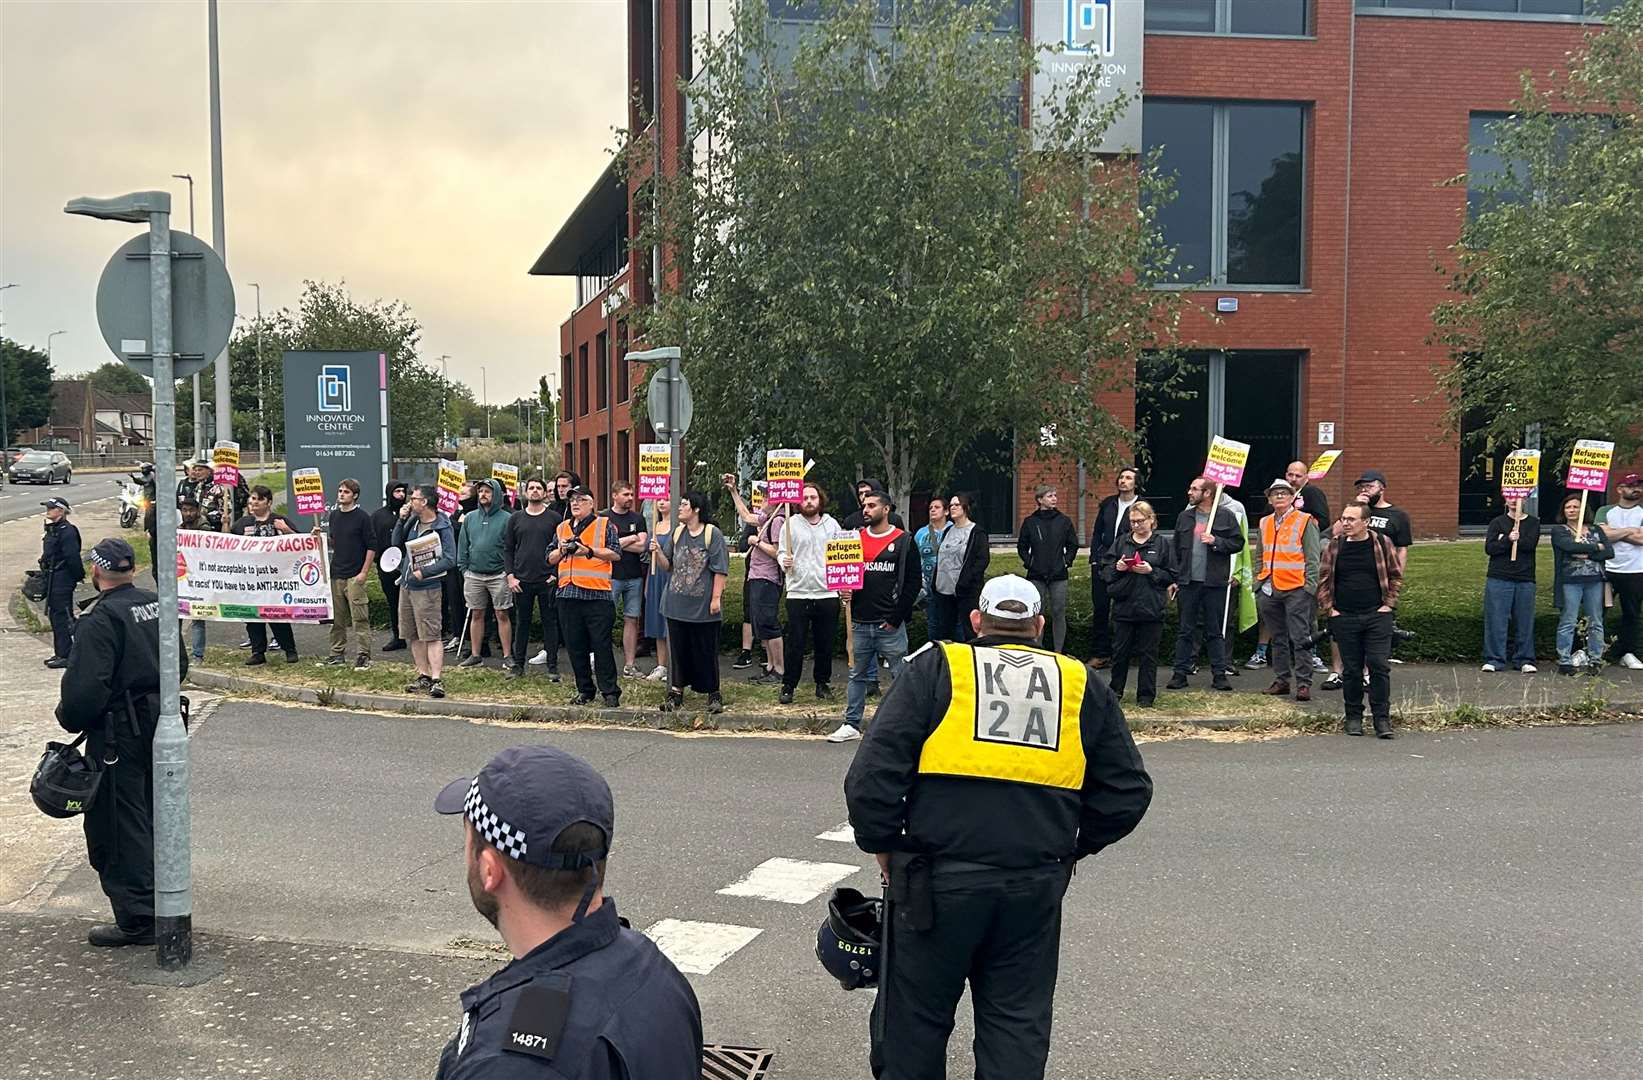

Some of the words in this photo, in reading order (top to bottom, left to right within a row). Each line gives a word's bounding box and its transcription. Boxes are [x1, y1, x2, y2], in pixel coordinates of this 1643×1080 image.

[306, 414, 365, 423] INNOVATION
[317, 422, 354, 431] CENTRE
[1212, 444, 1246, 458] Refugees
[1574, 448, 1610, 459] Refugees
[641, 455, 669, 465] Refugees
[1211, 453, 1243, 464] welcome
[1573, 457, 1607, 466] welcome
[641, 464, 668, 472] welcome
[769, 460, 802, 470] Refugees
[769, 469, 800, 477] welcome
[1571, 467, 1589, 477] Stop
[1590, 469, 1604, 477] the
[641, 476, 655, 485] Stop
[656, 476, 666, 484] the
[769, 481, 785, 490] Stop
[787, 480, 800, 489] the
[1570, 475, 1581, 483] far
[1582, 476, 1602, 486] right
[640, 485, 651, 493] far
[651, 485, 665, 495] right
[769, 490, 780, 498] far
[781, 489, 799, 499] right
[205, 535, 241, 550] STAND
[241, 539, 258, 551] UP
[259, 540, 275, 553] TO
[827, 543, 861, 552] Refugees
[827, 552, 861, 561] welcome
[207, 562, 217, 572] not
[217, 564, 247, 576] acceptable
[248, 565, 255, 574] to
[256, 564, 269, 576] just
[269, 565, 279, 574] be
[828, 565, 846, 575] Stop
[847, 564, 860, 573] the
[828, 575, 840, 584] far
[841, 574, 859, 584] right
[212, 580, 223, 590] YOU
[224, 581, 238, 590] have
[239, 581, 246, 591] to
[246, 581, 256, 591] be
[256, 581, 300, 591] ANTI-RACIST!
[984, 662, 1010, 696] K
[1026, 666, 1053, 702] A
[989, 700, 1010, 738] 2
[1023, 707, 1049, 745] A
[838, 940, 872, 955] 12703
[512, 1032, 547, 1049] 14871
